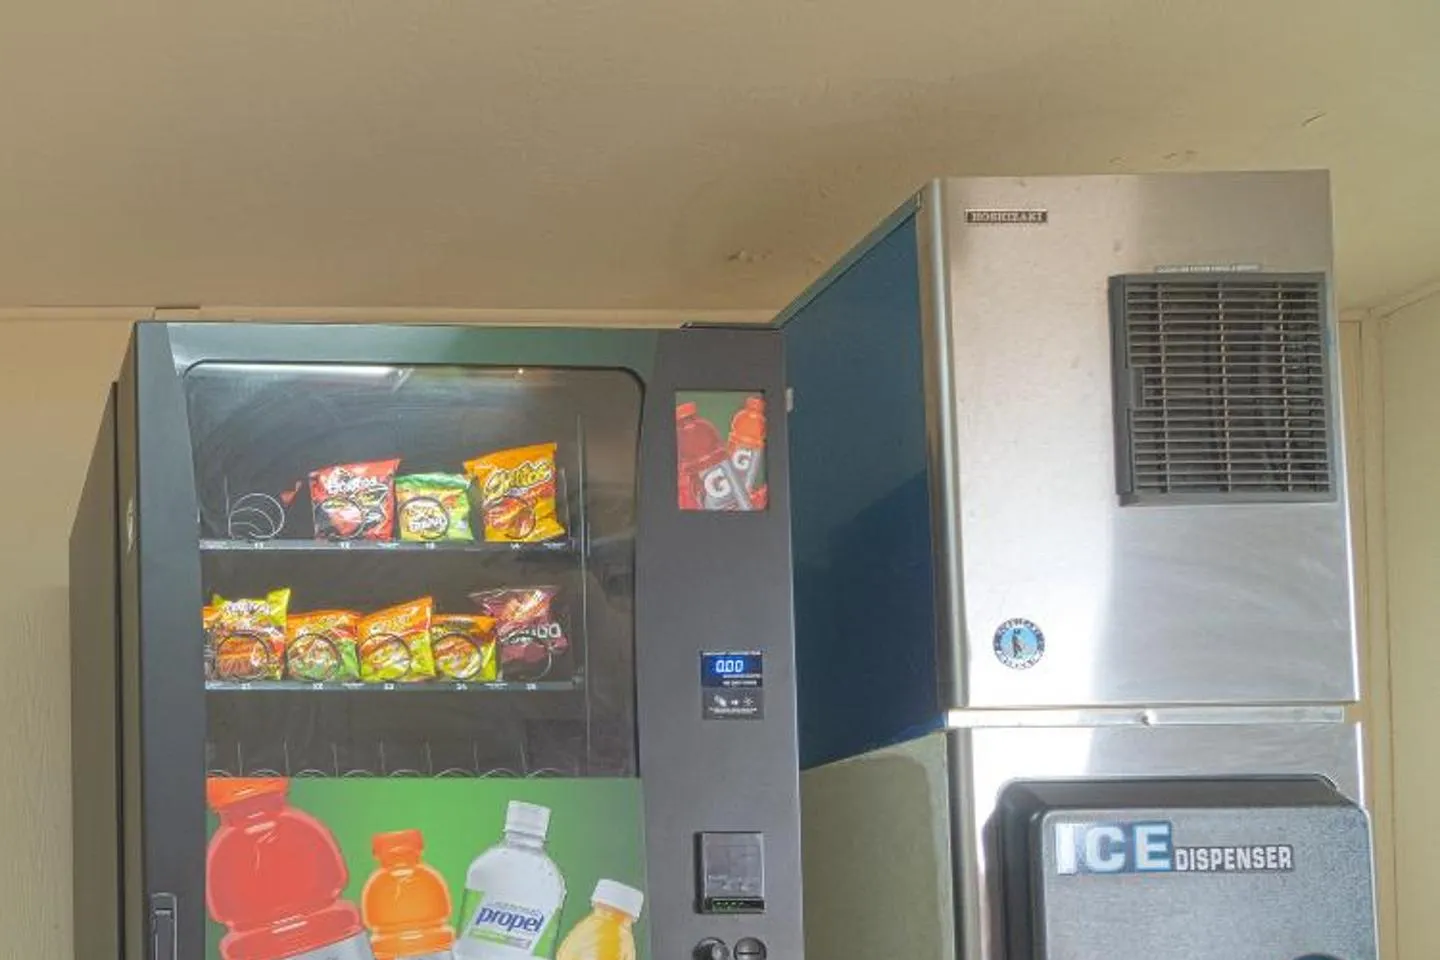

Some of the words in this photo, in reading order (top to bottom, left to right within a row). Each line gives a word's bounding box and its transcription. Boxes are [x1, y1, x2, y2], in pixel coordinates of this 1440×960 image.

[732, 447, 752, 470] G
[704, 466, 731, 498] G
[1055, 822, 1171, 875] ICE
[1174, 845, 1294, 872] DISPENSER
[475, 906, 545, 933] propel
